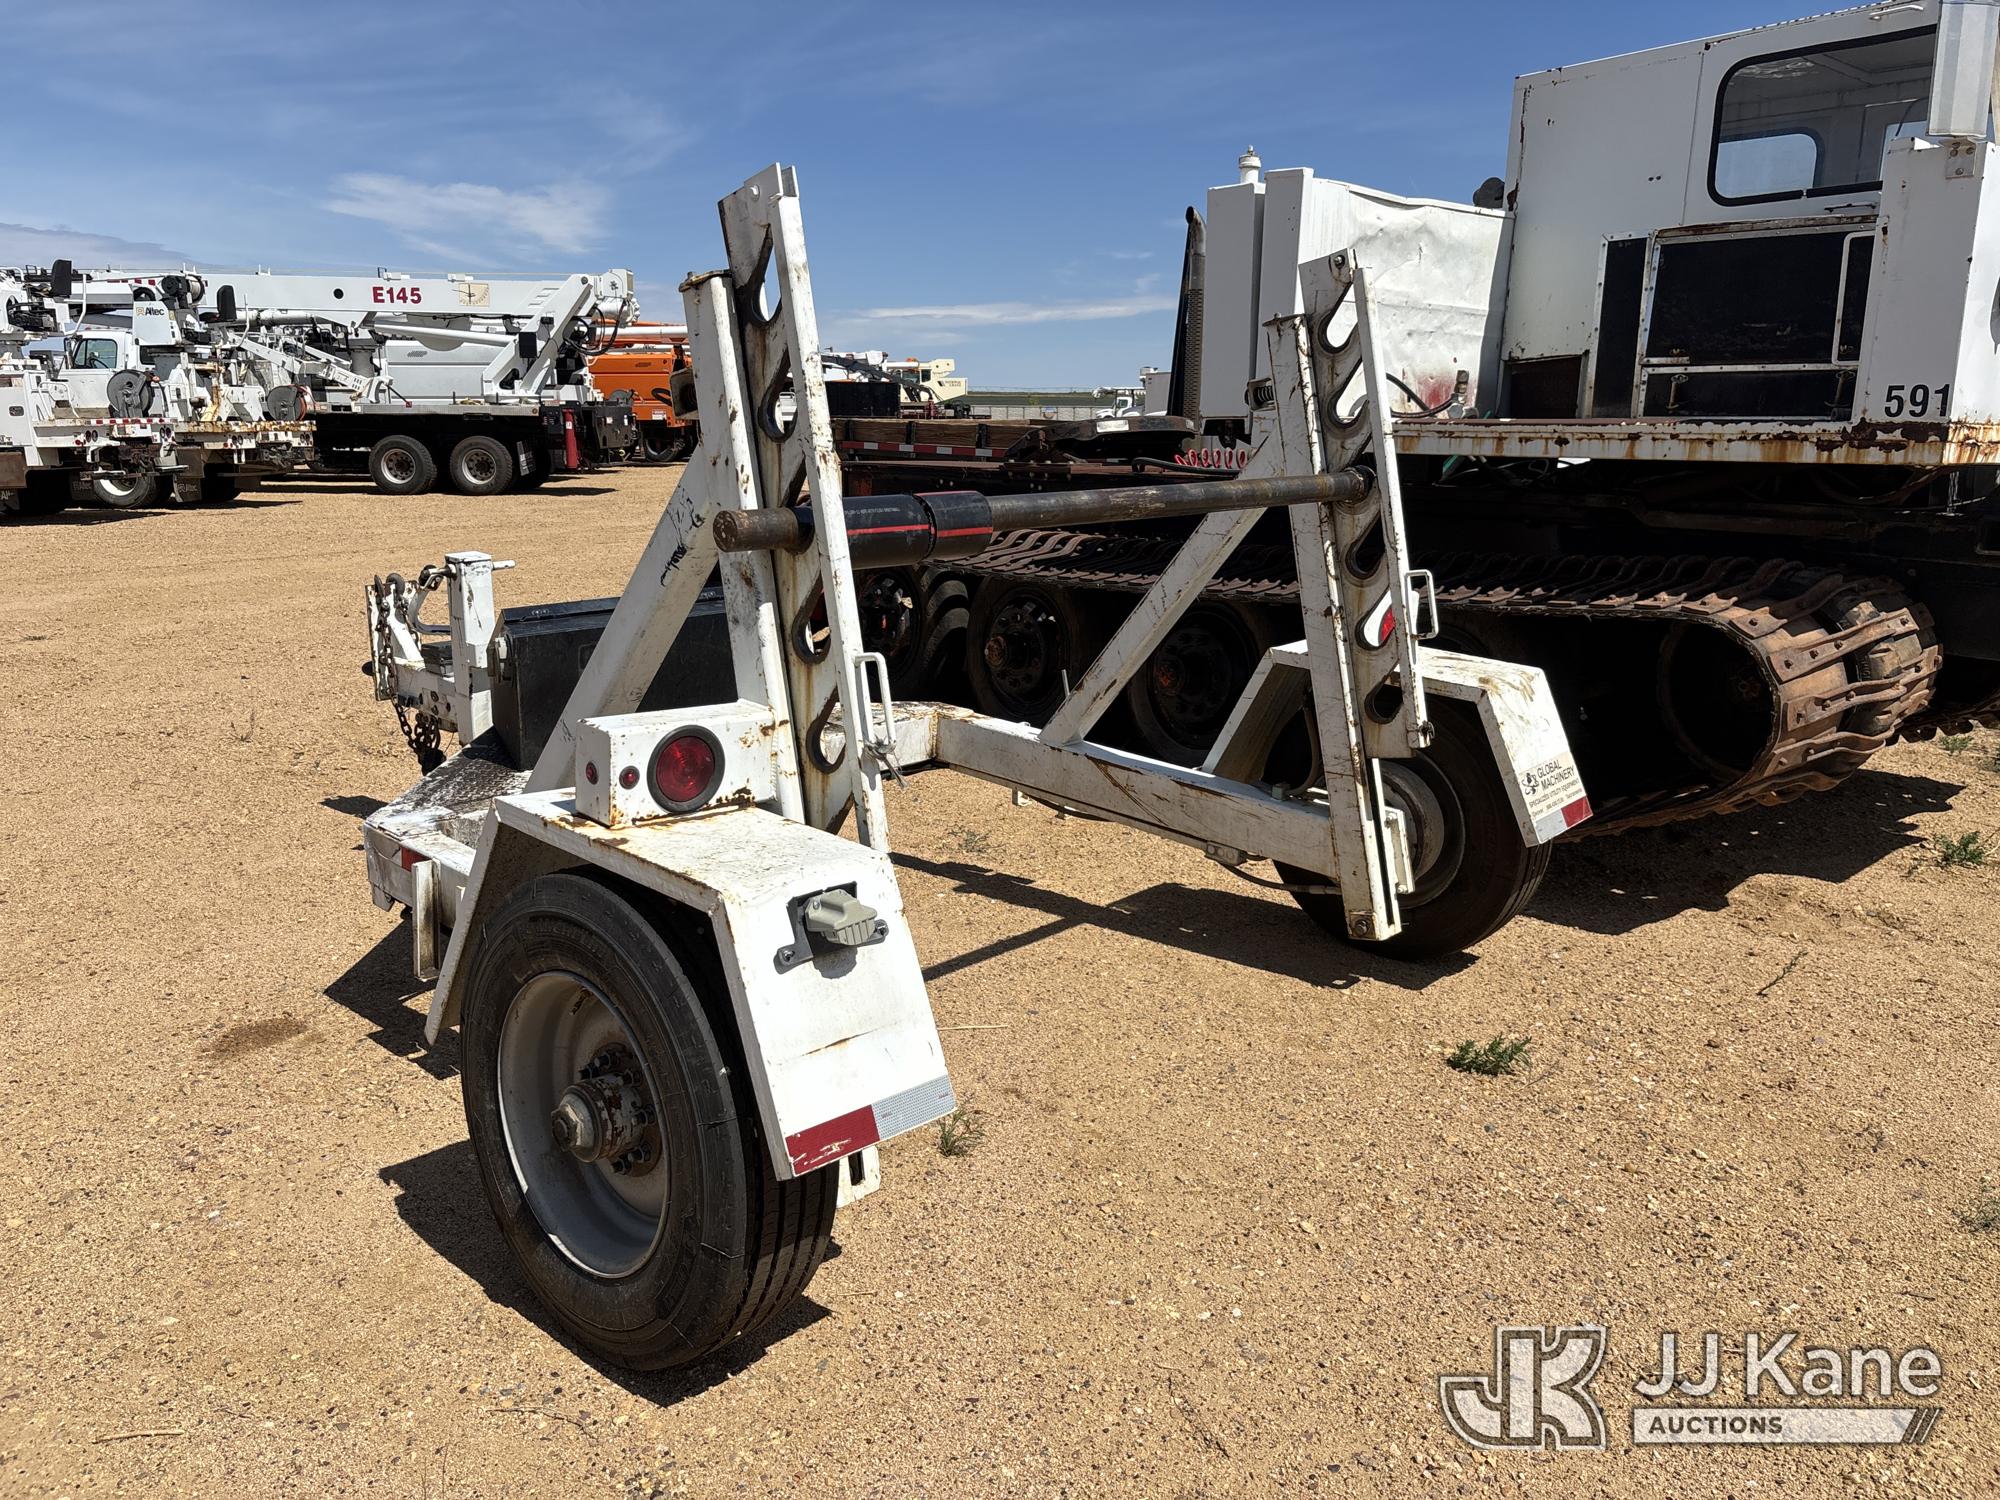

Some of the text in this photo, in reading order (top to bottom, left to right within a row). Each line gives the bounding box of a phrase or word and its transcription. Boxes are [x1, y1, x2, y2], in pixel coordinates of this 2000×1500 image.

[372, 286, 422, 304] E145
[145, 307, 164, 316] Altec
[1884, 384, 1950, 418] 591
[1537, 760, 1562, 779] GLOBAL
[1541, 766, 1575, 791] MACHINERY
